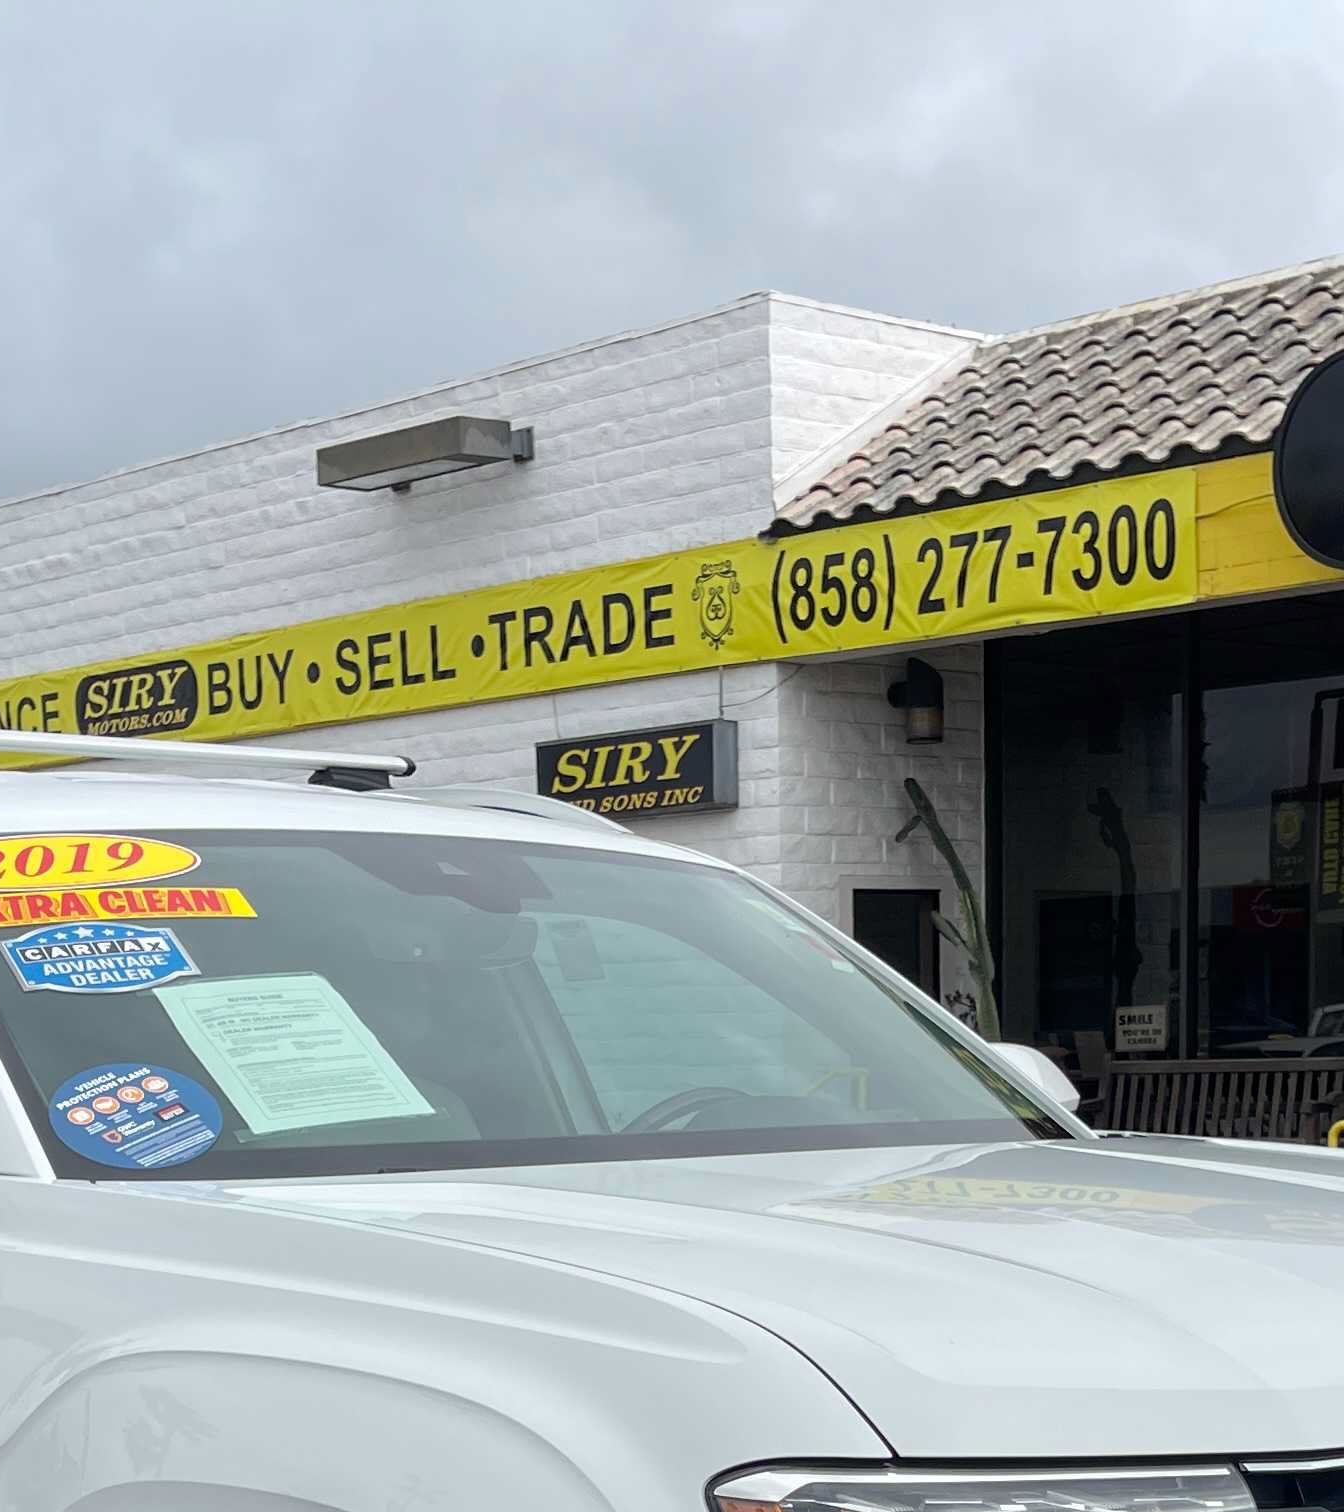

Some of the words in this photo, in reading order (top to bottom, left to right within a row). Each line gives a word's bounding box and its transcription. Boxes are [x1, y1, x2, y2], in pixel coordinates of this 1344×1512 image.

[772, 533, 896, 642] (858)
[916, 496, 1177, 615] 277-7300
[205, 648, 295, 715] BUY
[335, 624, 457, 696] SELL
[488, 583, 676, 672] TRADE
[84, 666, 192, 721] SIRY
[551, 733, 701, 795] SIRY
[599, 791, 658, 814] SONS
[660, 786, 705, 807] INC
[98, 888, 225, 917] CLEAN
[22, 937, 165, 962] CARFAX
[43, 953, 170, 977] ADVANTAGE
[71, 967, 155, 987] DEALER
[56, 1081, 119, 1111] PROTECTION
[118, 1066, 152, 1085] PLANS
[73, 1071, 117, 1093] VEHICLE
